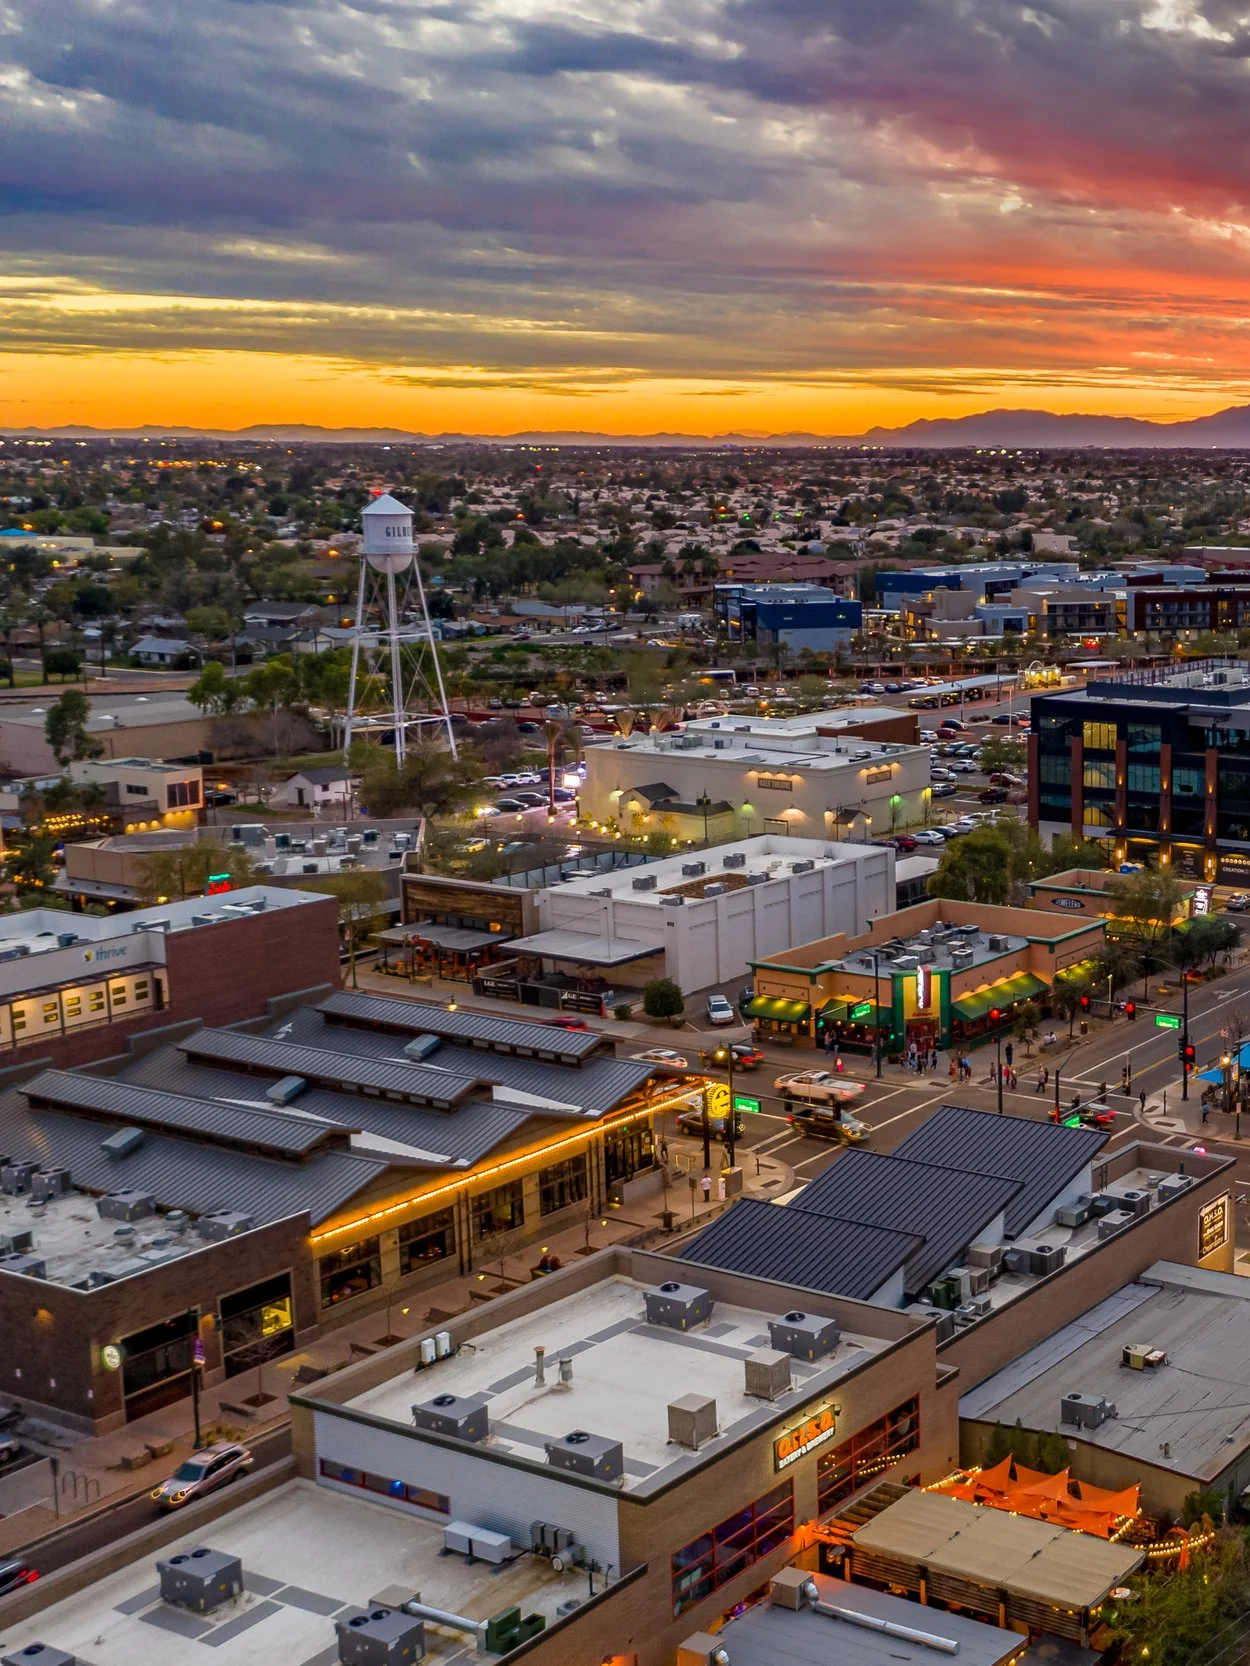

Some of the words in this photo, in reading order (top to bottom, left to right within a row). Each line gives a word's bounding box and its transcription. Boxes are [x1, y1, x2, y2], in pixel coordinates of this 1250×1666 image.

[95, 944, 127, 961] thrive
[779, 1447, 801, 1469] EATERY
[806, 1426, 835, 1451] BREWERY
